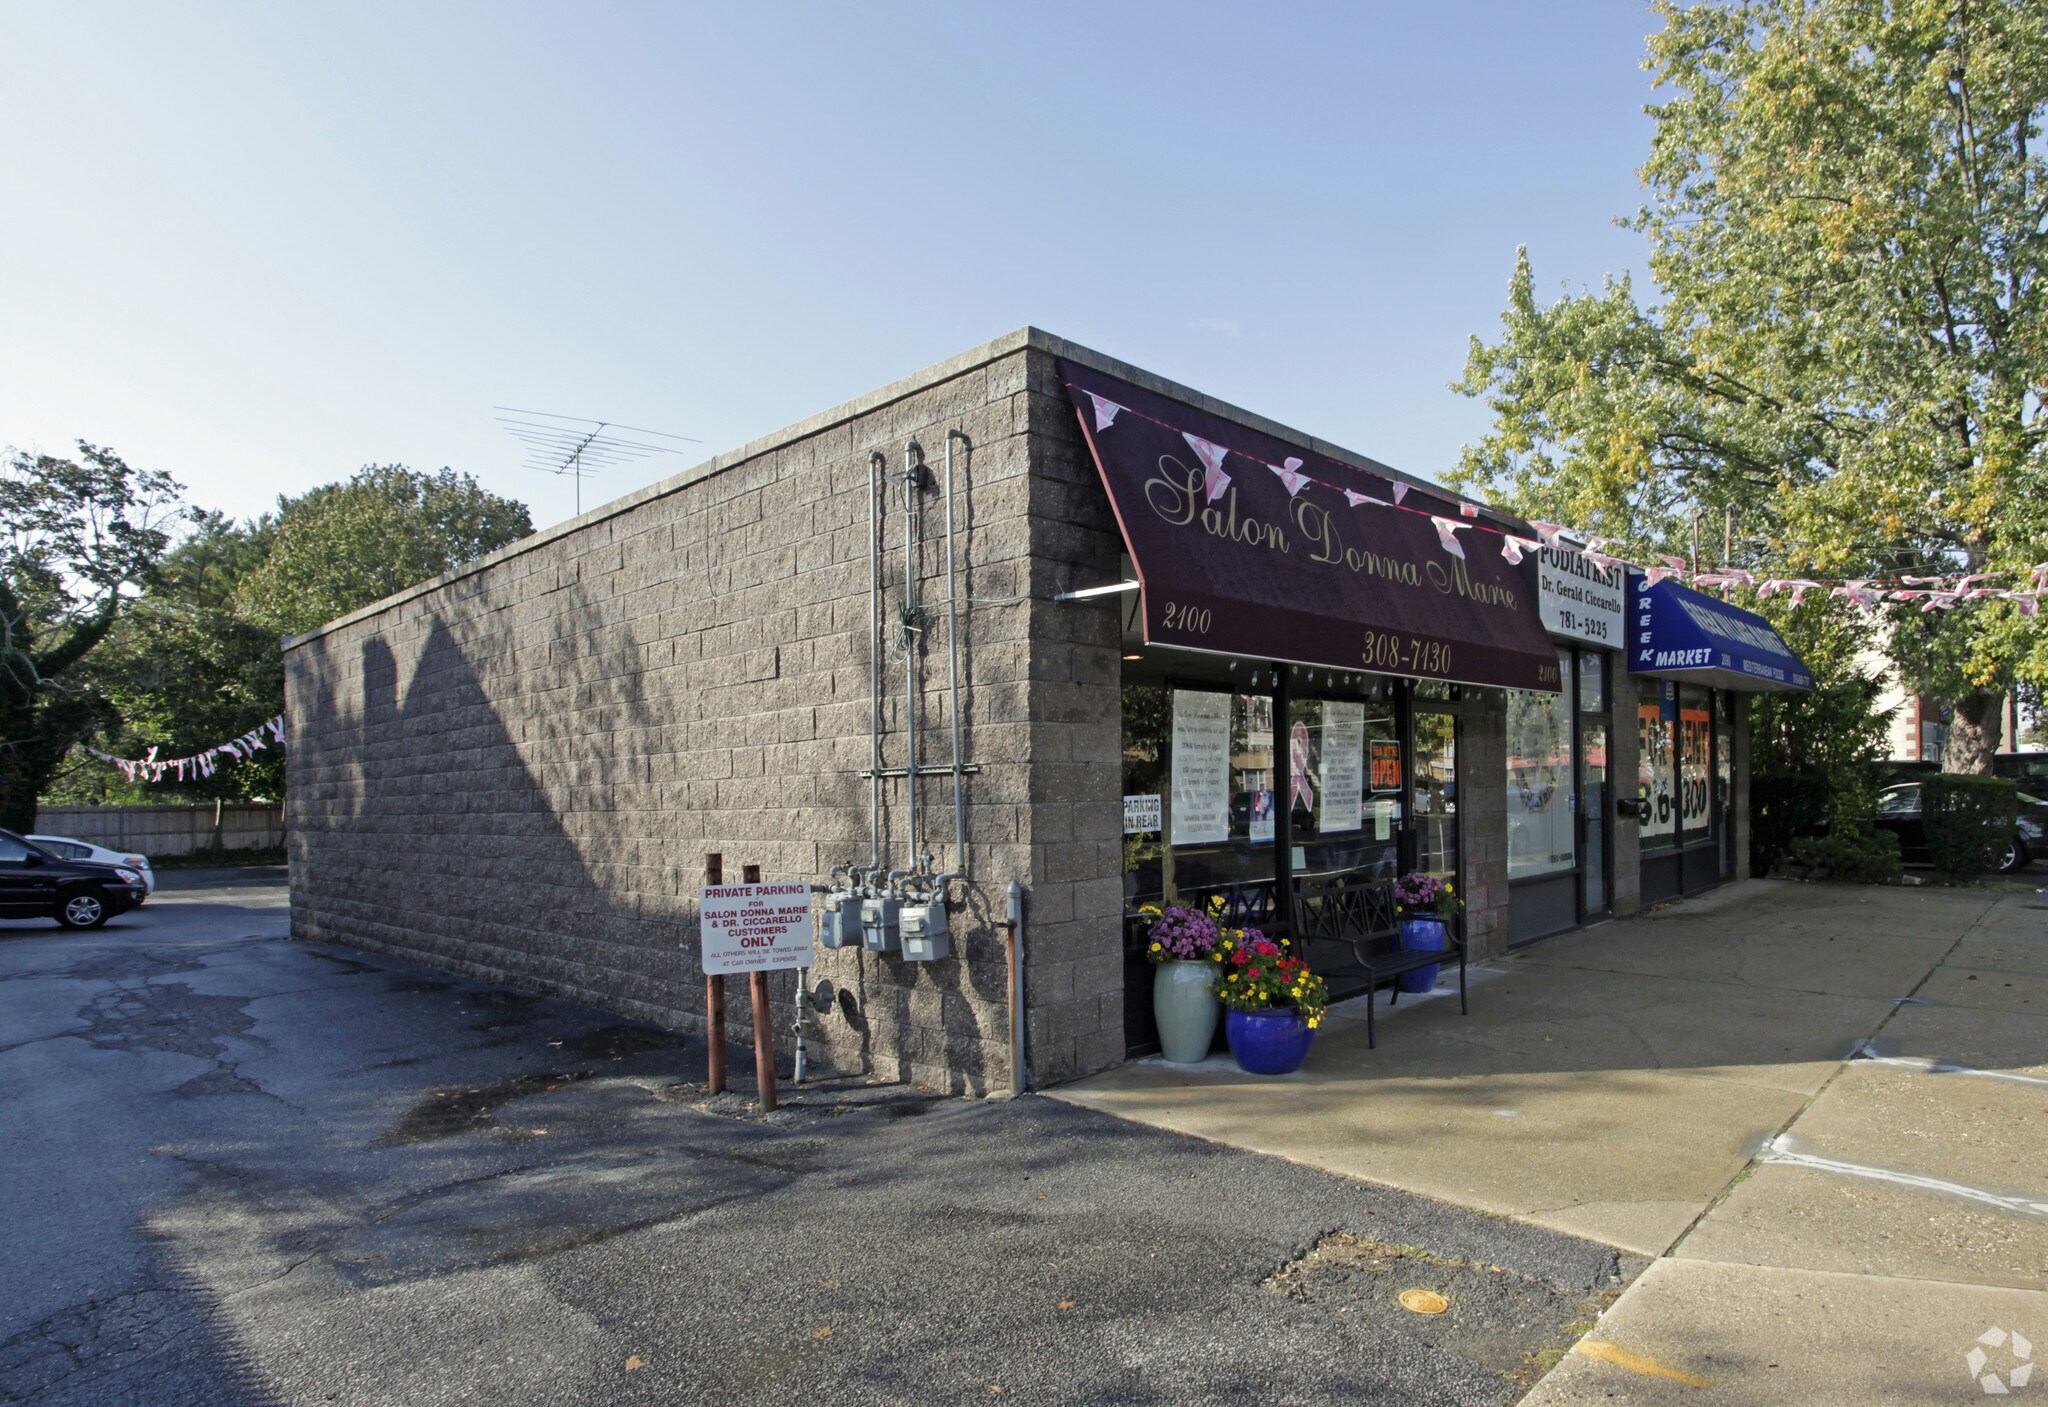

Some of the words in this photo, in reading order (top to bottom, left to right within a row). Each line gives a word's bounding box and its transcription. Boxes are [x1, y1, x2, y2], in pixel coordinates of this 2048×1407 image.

[1144, 454, 1290, 553] Salon
[1289, 489, 1422, 587] Donna
[1427, 555, 1517, 610] Marie
[1542, 575, 1554, 593] Dr.
[1557, 580, 1583, 603] Gerald
[1585, 590, 1621, 614] Ciccarello
[1162, 601, 1211, 634] 2100
[1362, 631, 1450, 674] 308-7130
[1656, 648, 1711, 667] MARKET
[1538, 664, 1557, 683] 2100
[1372, 759, 1400, 786] OPEN
[1123, 798, 1159, 813] PARKING
[1125, 816, 1134, 829] IN
[1136, 814, 1159, 828] REAR
[705, 887, 752, 899] PRIVATE
[756, 884, 804, 896] PARKING
[704, 910, 737, 919] SALON
[741, 908, 775, 917] DONNA
[778, 906, 808, 915] MARIE
[712, 920, 718, 928] &
[723, 919, 739, 927] DR.
[743, 915, 802, 926] CICCARELLO
[728, 926, 788, 937] CUSTOMERS
[741, 936, 775, 948] ONLY
